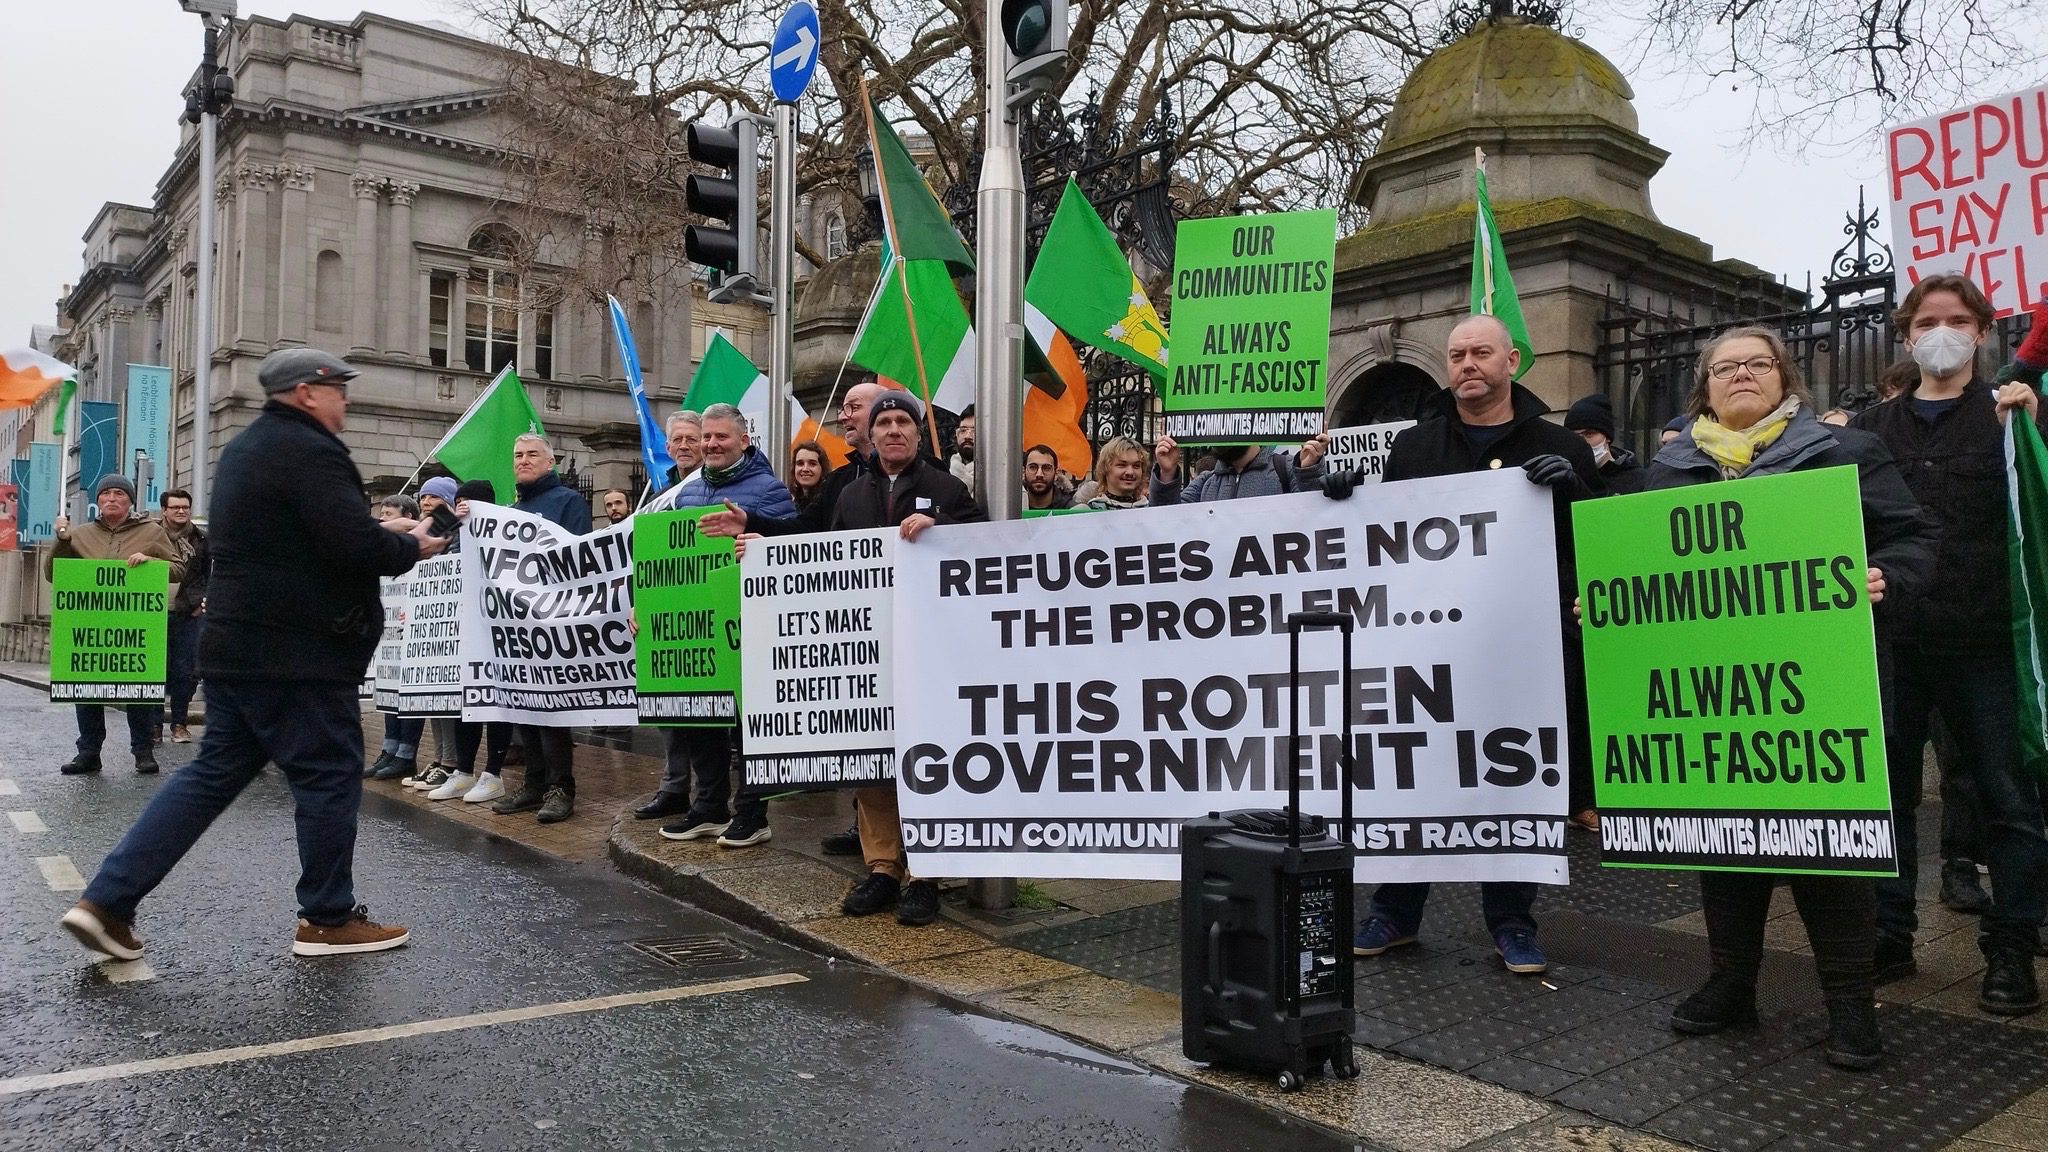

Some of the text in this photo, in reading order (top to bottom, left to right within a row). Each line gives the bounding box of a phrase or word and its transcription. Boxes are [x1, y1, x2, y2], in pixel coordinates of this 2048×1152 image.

[1909, 183, 2011, 261] SAY
[1232, 225, 1275, 257] OUR
[1177, 260, 1328, 299] COMMUNITIES
[1202, 320, 1292, 355] ALWAYS
[1172, 360, 1321, 395] ANTI-FASCIST
[1166, 412, 1324, 437] DUBLIN COMMUNITIES AGAINST RACISM
[1324, 432, 1378, 456] USING
[669, 519, 696, 549] OUR
[1669, 500, 1746, 557] OUR
[477, 531, 633, 586] NFOMATI
[766, 537, 883, 566] FUNDING FOR
[940, 511, 1497, 597] REFUGEES ARE NOT
[96, 566, 127, 587] OUR
[418, 560, 461, 579] HOUSING &
[744, 567, 895, 599] OUR COMMUNITIE
[56, 591, 164, 612] COMMUNITIES
[410, 580, 439, 598] HEALTH
[441, 578, 463, 595] CRISI
[480, 574, 633, 620] ONSULTATI
[1587, 555, 1858, 628] COMMUNITIES
[414, 603, 445, 621] CAUSED
[447, 601, 459, 617] BY
[650, 608, 715, 641] WELCOME
[825, 607, 872, 634] MAKE
[72, 628, 147, 648] WELCOME
[410, 622, 427, 639] THIS
[429, 620, 460, 638] ROTTEN
[491, 619, 634, 660] RESOURC
[991, 605, 1093, 649] THE
[71, 652, 147, 673] REFUGEES
[406, 639, 460, 658] GOVERNMENT
[651, 646, 716, 679] REFUGEES
[772, 640, 879, 670] INTEGRATION
[401, 667, 415, 684] NOT
[415, 666, 425, 684] BY
[426, 664, 461, 683] REFUGEES
[529, 658, 636, 685] INTEGRATIO
[51, 684, 165, 698] DUBLIN COMMUNITIES AGAINST RACISM
[466, 688, 511, 706] DULIN
[511, 690, 600, 709] COMMUNITIES
[776, 674, 877, 703] BENEFIT THE
[958, 664, 1455, 736] THIS ROTTEN
[1647, 660, 1806, 719] ALWAYS
[638, 696, 656, 717] DUBLIN
[656, 696, 690, 717] COMMUNITIES
[691, 696, 713, 717] AGAINST
[714, 695, 735, 717] RACISM
[748, 706, 895, 738] WHOLE COMMUNIT
[746, 759, 778, 785] DUBLIN
[780, 756, 840, 784] COMMUNITIES
[842, 754, 880, 781] AGAINST
[902, 726, 1561, 795] GOVERNMENT IS!
[1604, 728, 1869, 784] ANTI-FASCIST
[904, 820, 1565, 850] DUBLIN COMMUNI INST RACISM
[1602, 816, 1893, 859] DUBLIN COMMUNITIES AGAINST RACISM
